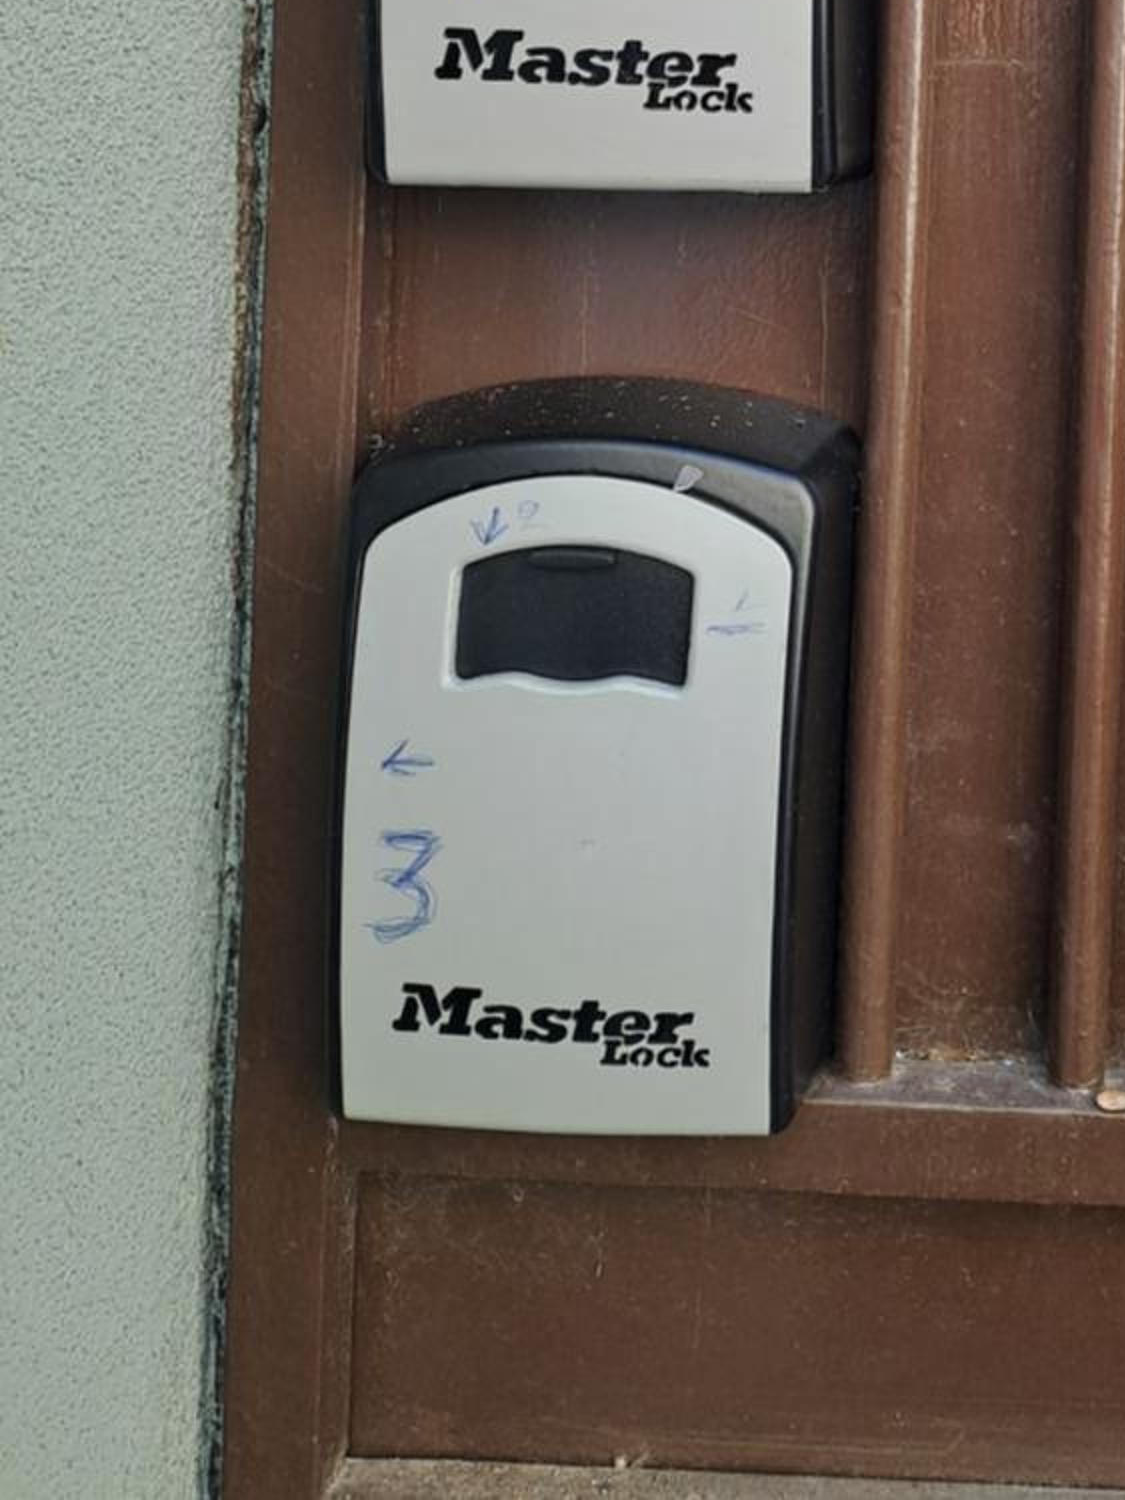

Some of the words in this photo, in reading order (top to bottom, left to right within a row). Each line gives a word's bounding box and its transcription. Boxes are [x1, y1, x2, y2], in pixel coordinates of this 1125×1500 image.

[435, 27, 738, 88] Master
[643, 82, 754, 113] Lock
[363, 828, 441, 943] 3
[391, 983, 696, 1046] Master
[599, 1040, 711, 1068] Lock
